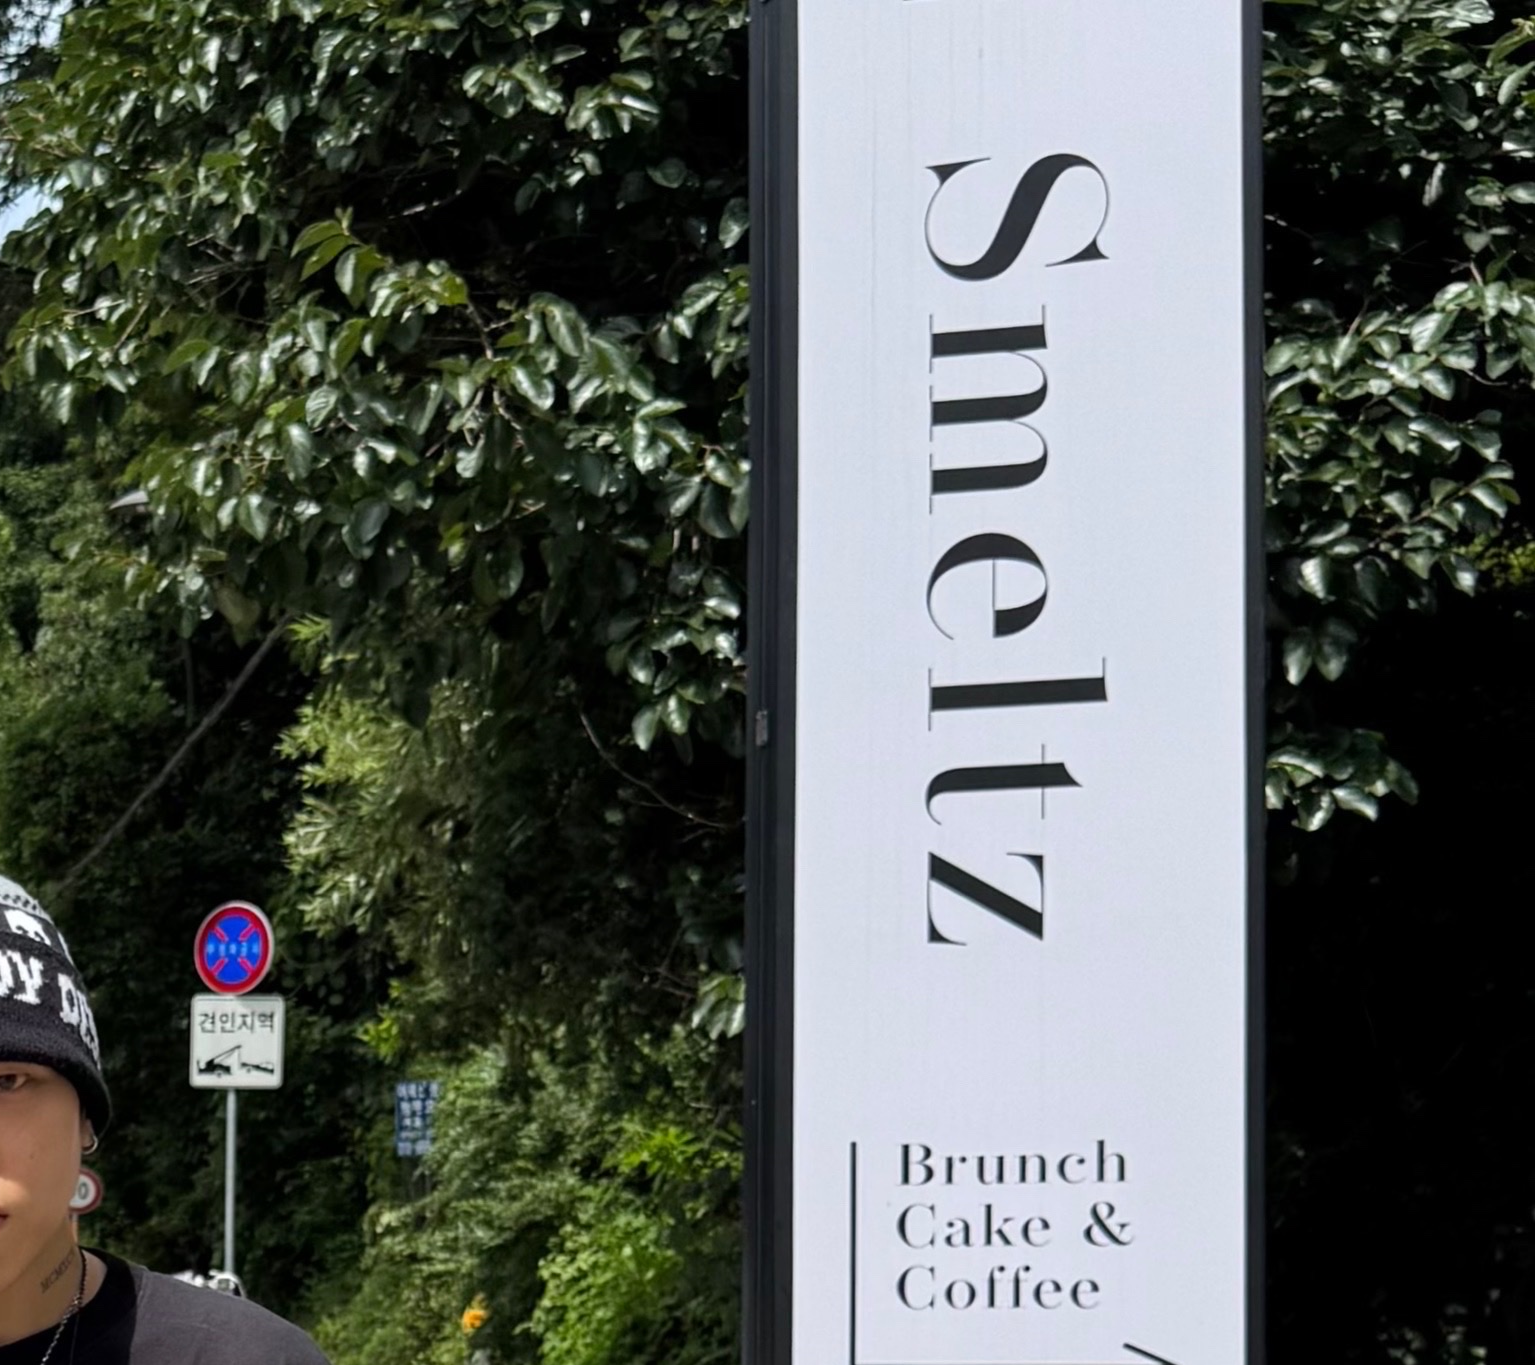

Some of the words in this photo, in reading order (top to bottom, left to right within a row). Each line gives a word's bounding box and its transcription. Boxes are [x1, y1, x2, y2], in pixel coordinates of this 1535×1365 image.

[924, 152, 1111, 946] Smeltz
[198, 1011, 275, 1034] 견인지역
[895, 1139, 1128, 1187] Brunch
[895, 1202, 1054, 1250] Cake
[1082, 1201, 1135, 1248] &
[895, 1264, 1102, 1311] Coffee
